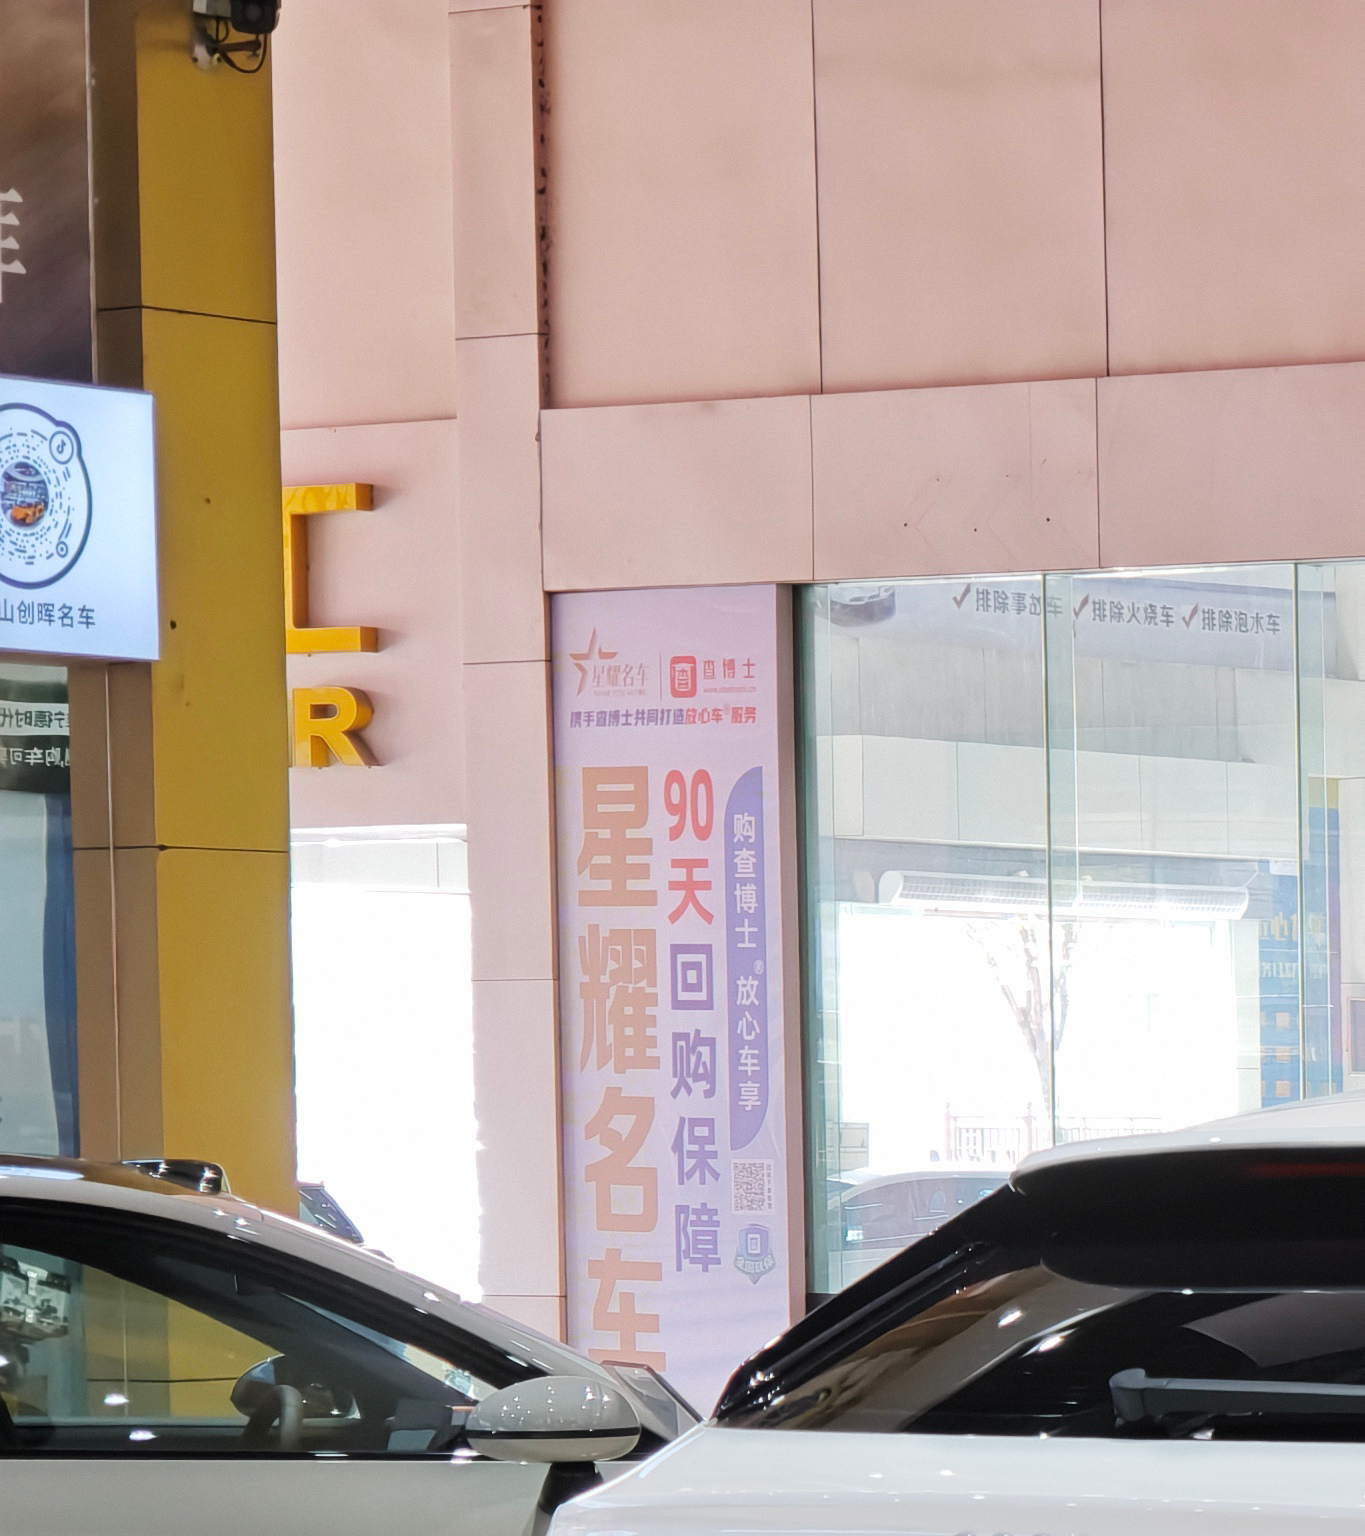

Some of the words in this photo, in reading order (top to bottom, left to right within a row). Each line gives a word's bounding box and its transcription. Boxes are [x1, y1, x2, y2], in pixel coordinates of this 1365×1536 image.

[1091, 598, 1175, 628] 排除火烧车
[1201, 608, 1282, 636] 排除泡水车
[577, 766, 666, 1372] 星耀名车
